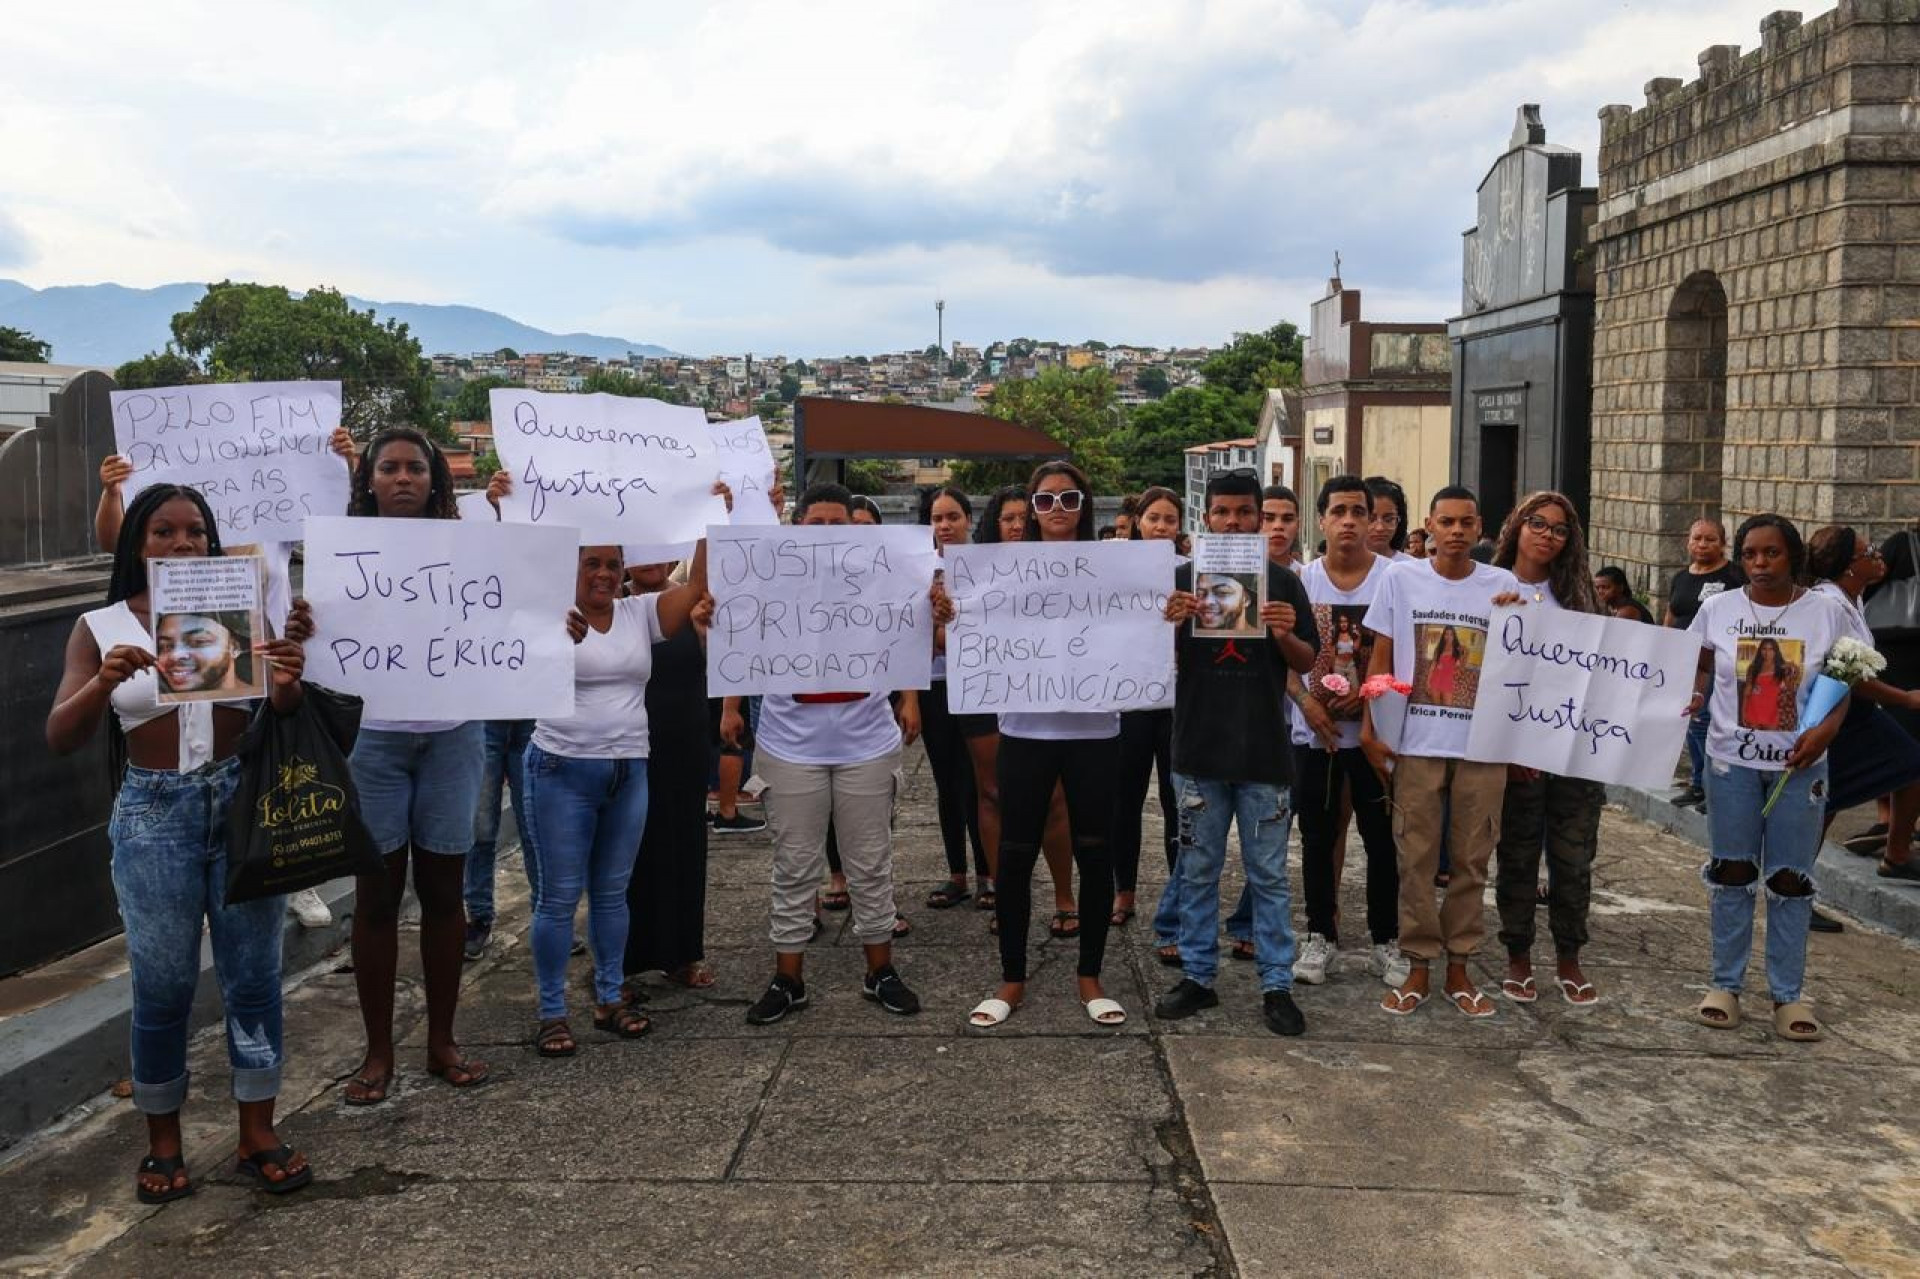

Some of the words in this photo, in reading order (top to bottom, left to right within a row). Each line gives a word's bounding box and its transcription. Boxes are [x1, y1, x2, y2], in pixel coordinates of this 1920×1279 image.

[117, 393, 235, 439] PELO
[250, 395, 321, 432] FIM
[514, 401, 697, 458] Queremos
[251, 468, 288, 494] AS
[523, 455, 658, 523] Justiça
[716, 538, 891, 596] JUSTIÇA
[952, 555, 976, 590] A
[989, 555, 1098, 584] MAIOR
[1411, 609, 1456, 621] Saudades
[1459, 612, 1490, 628] eterna
[330, 638, 407, 676] POR
[956, 632, 1057, 669] BRASIL
[1502, 614, 1665, 689] Queremos
[960, 662, 1168, 711] FEMINICÍDIO
[1410, 705, 1437, 717] Erica
[1439, 708, 1474, 721] Pereir
[1503, 683, 1633, 755] Justiça
[258, 790, 338, 828] Lolita
